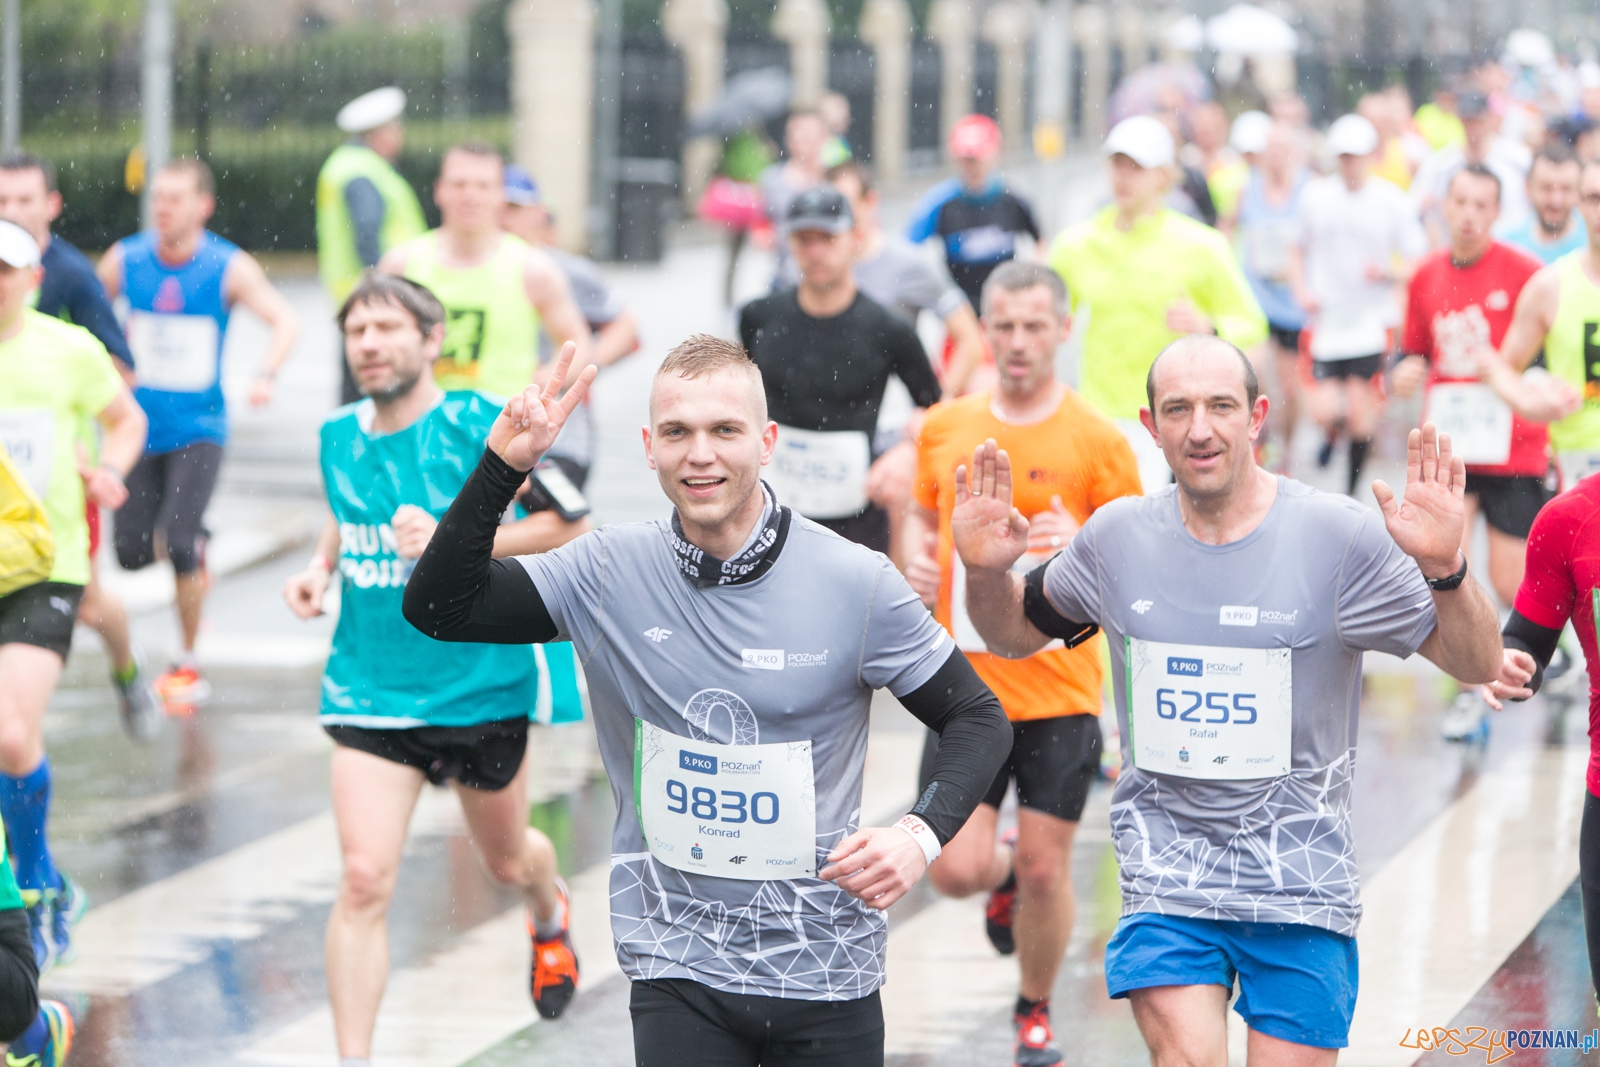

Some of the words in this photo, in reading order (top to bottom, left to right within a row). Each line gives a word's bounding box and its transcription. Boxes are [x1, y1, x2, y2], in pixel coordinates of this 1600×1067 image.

[1131, 599, 1154, 615] 4F
[643, 626, 673, 643] 4F
[1156, 688, 1258, 725] 6255
[1189, 728, 1218, 739] Rafał
[1212, 755, 1229, 765] 4F
[666, 779, 780, 825] 9830
[698, 825, 741, 839] Konrad
[729, 855, 748, 865] 4F
